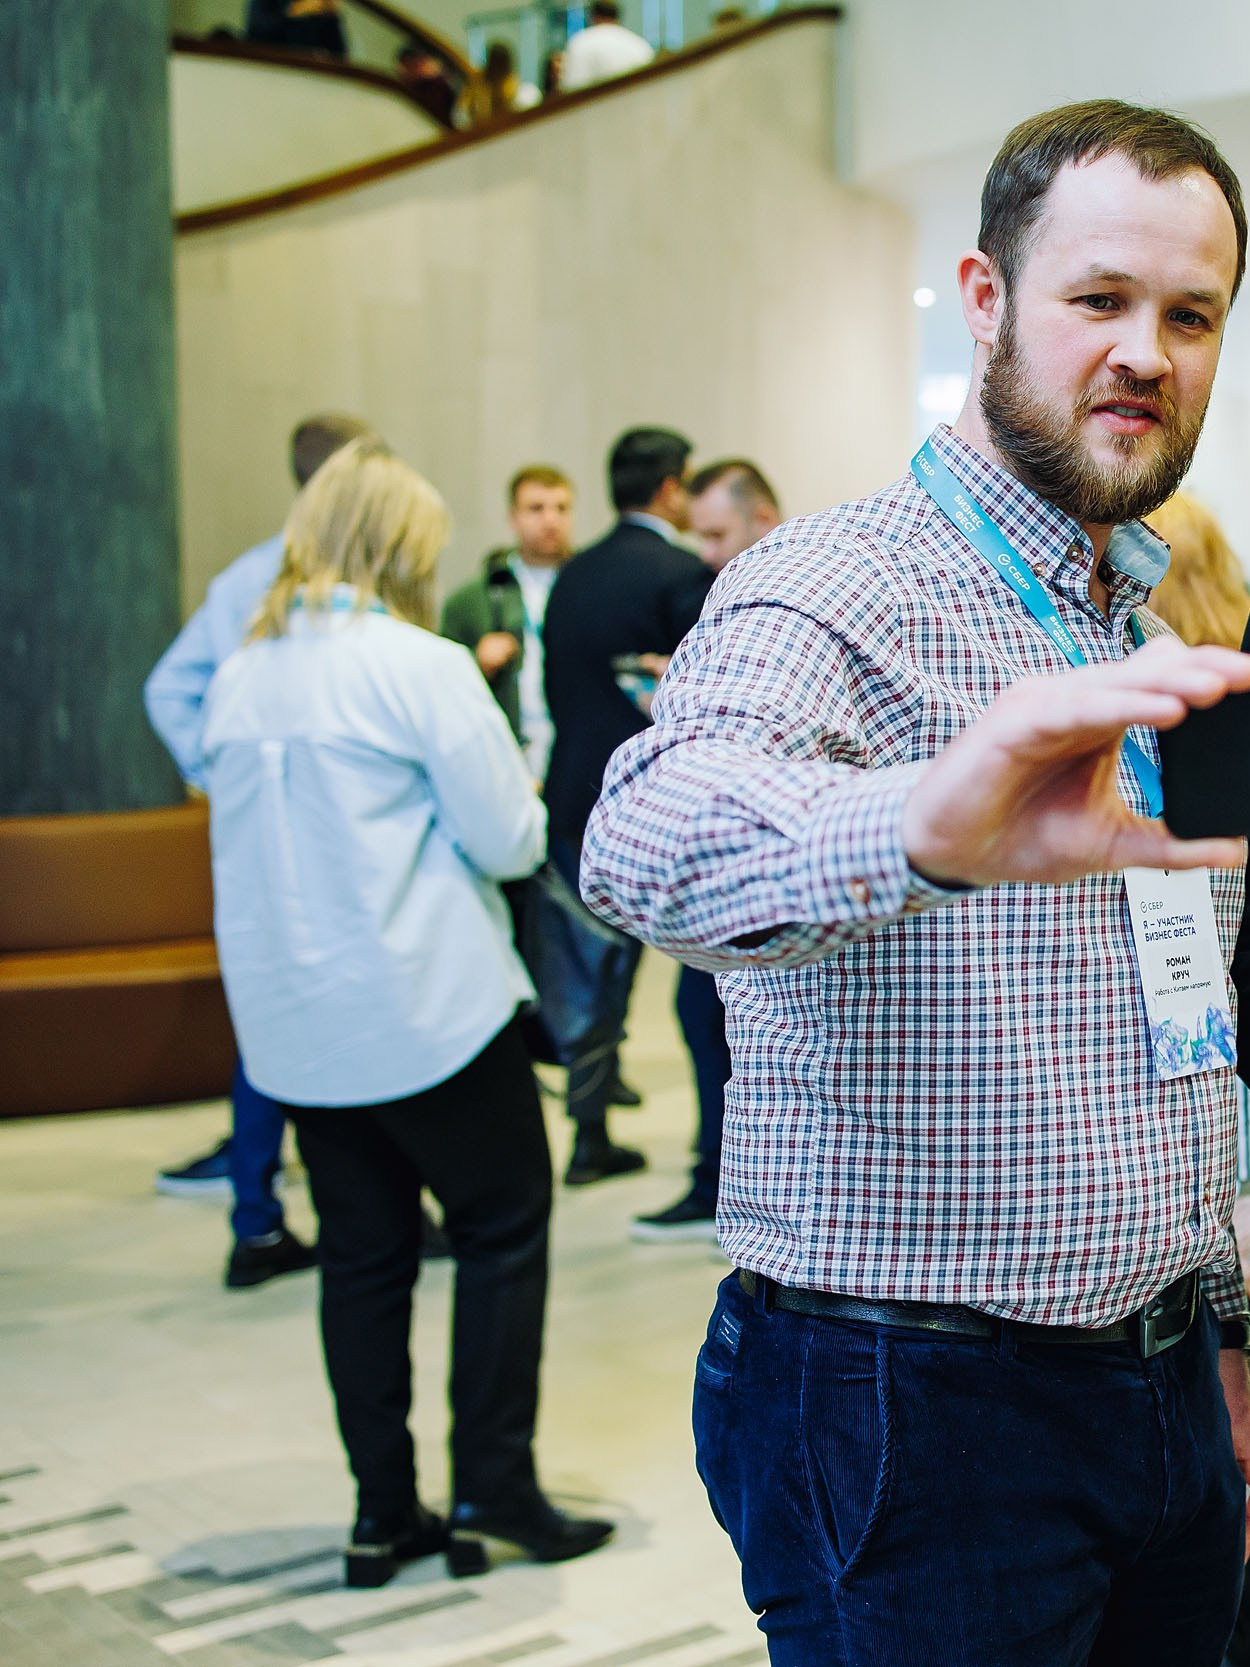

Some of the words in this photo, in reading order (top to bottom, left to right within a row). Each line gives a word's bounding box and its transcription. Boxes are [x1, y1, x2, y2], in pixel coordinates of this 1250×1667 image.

[919, 459, 935, 477] СБЕР
[953, 493, 985, 529] БИЗНЕС
[955, 511, 977, 533] ФЕСТ
[1008, 565, 1031, 591] СБЕР
[1049, 615, 1077, 652] БИЗНЕС
[1148, 901, 1164, 911] СБЕР
[1143, 920, 1149, 930] Я
[1157, 914, 1195, 928] УЧАСТНИК
[1144, 930, 1173, 942] БИЗНЕС
[1173, 927, 1197, 938] ФЕСТА
[1165, 955, 1192, 968] РОМАН
[1171, 969, 1190, 981] КРУЧ
